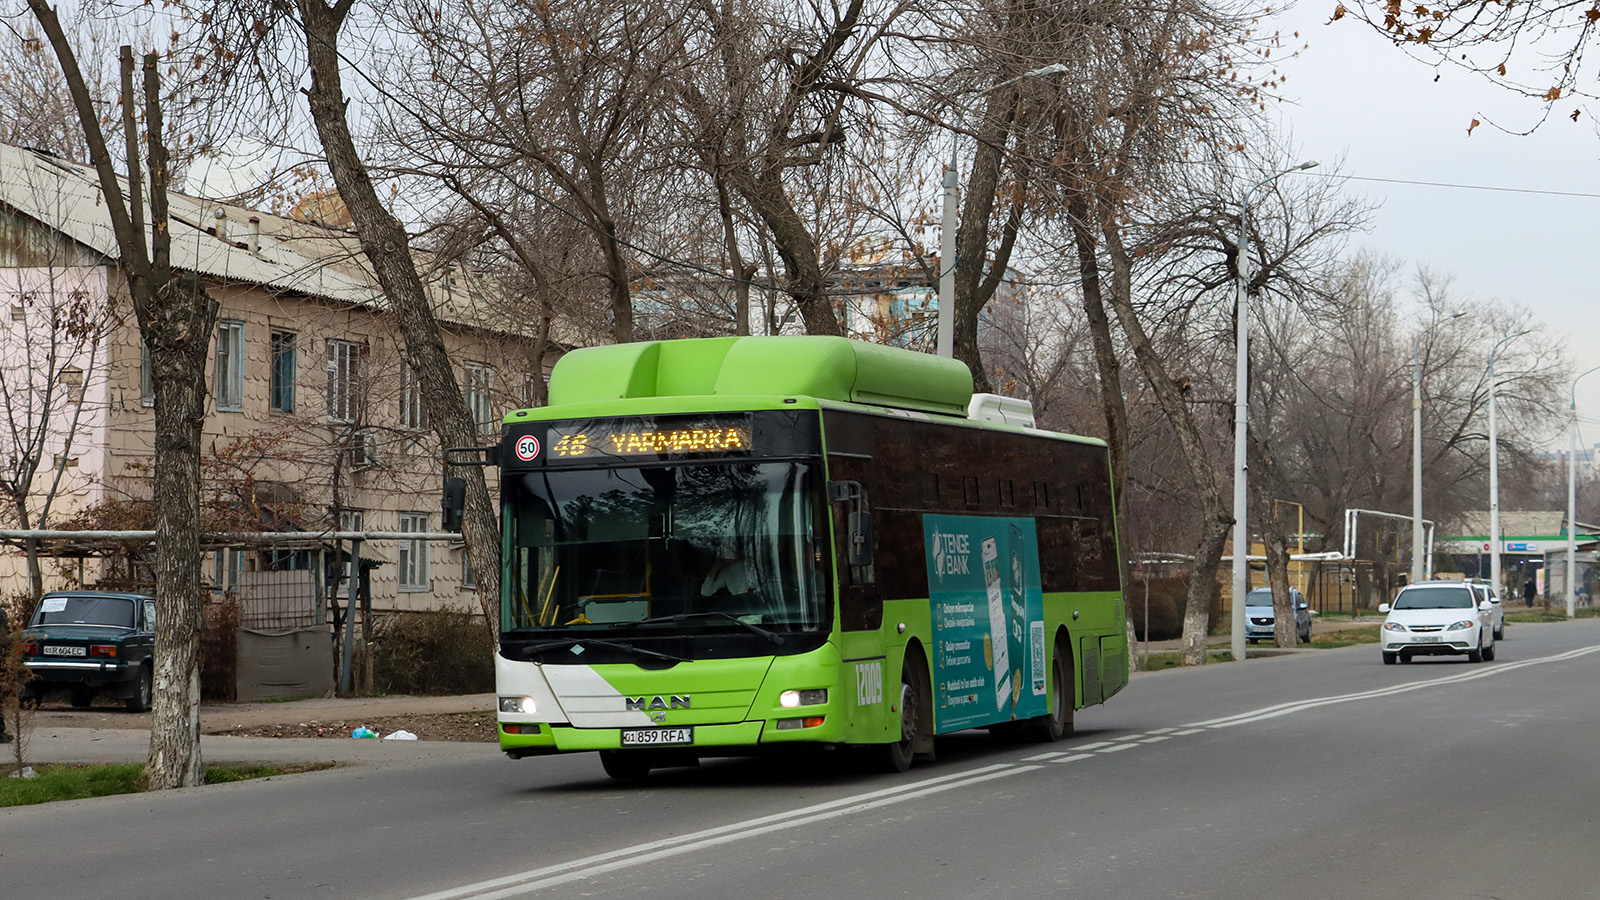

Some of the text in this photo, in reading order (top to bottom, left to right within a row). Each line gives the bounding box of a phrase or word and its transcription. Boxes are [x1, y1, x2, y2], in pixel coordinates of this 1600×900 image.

[519, 442, 535, 454] 50
[611, 429, 742, 452] YARMARKA
[942, 533, 970, 554] TENGE
[946, 555, 970, 575] BANK
[855, 662, 883, 706] 12009
[626, 695, 691, 710] MAN
[625, 730, 685, 743] 01 859 RFA
